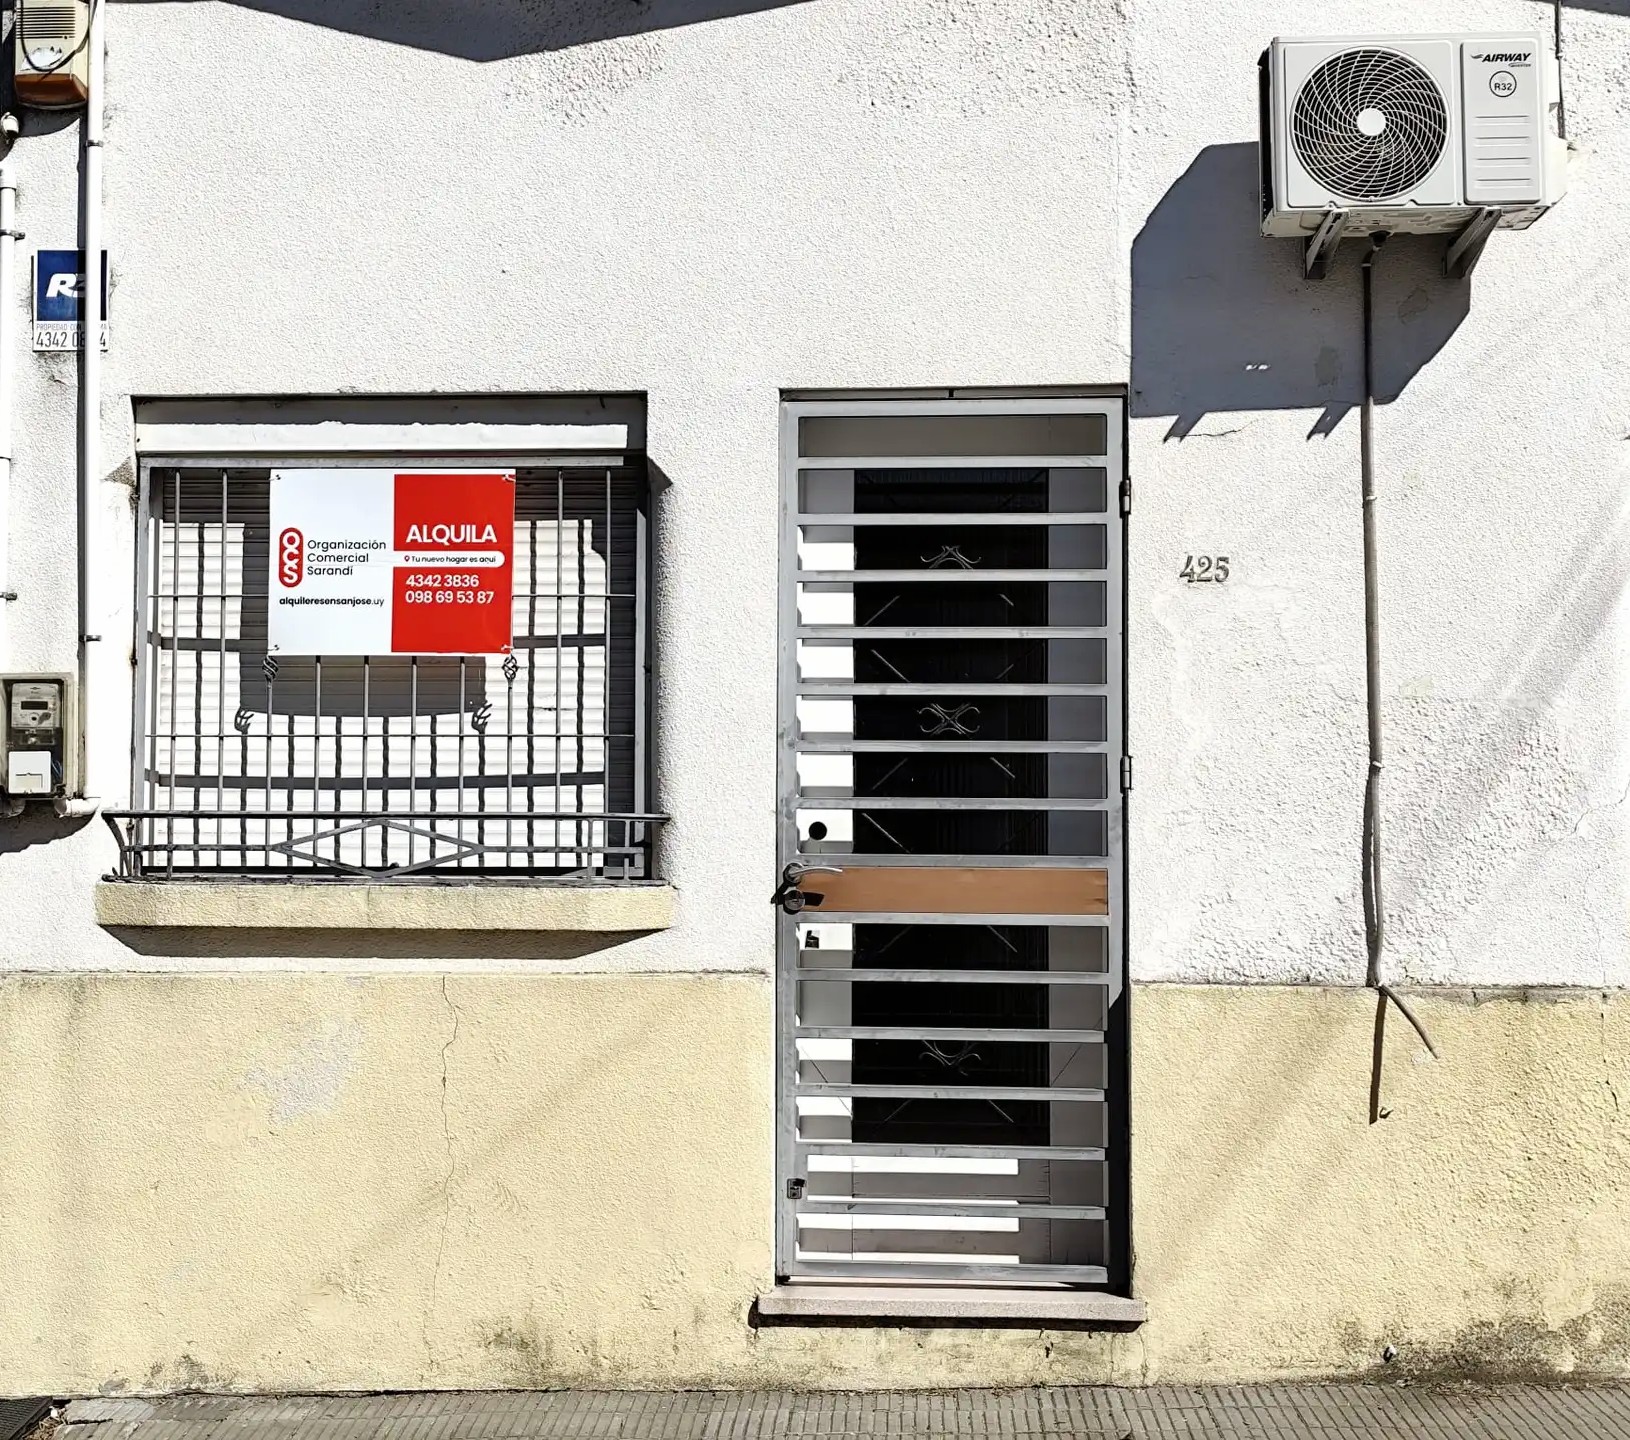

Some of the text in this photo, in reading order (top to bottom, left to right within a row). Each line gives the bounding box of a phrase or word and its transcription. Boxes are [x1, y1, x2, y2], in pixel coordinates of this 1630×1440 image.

[1481, 52, 1532, 63] AIRWAY
[1494, 82, 1513, 91] R32
[36, 323, 68, 331] PROPIEDAD
[36, 331, 106, 348] 4342 084
[405, 524, 498, 546] ALQUILA
[307, 539, 387, 553] Organización
[307, 552, 369, 563] Comercial
[411, 555, 421, 563] Tu
[446, 555, 468, 565] hogar
[307, 565, 354, 576] Sarandí
[1179, 555, 1230, 583] 425
[405, 574, 480, 588] 4342 3836
[279, 596, 385, 608] alquileresensanjose.uy
[405, 590, 495, 604] 098 69 53 87
